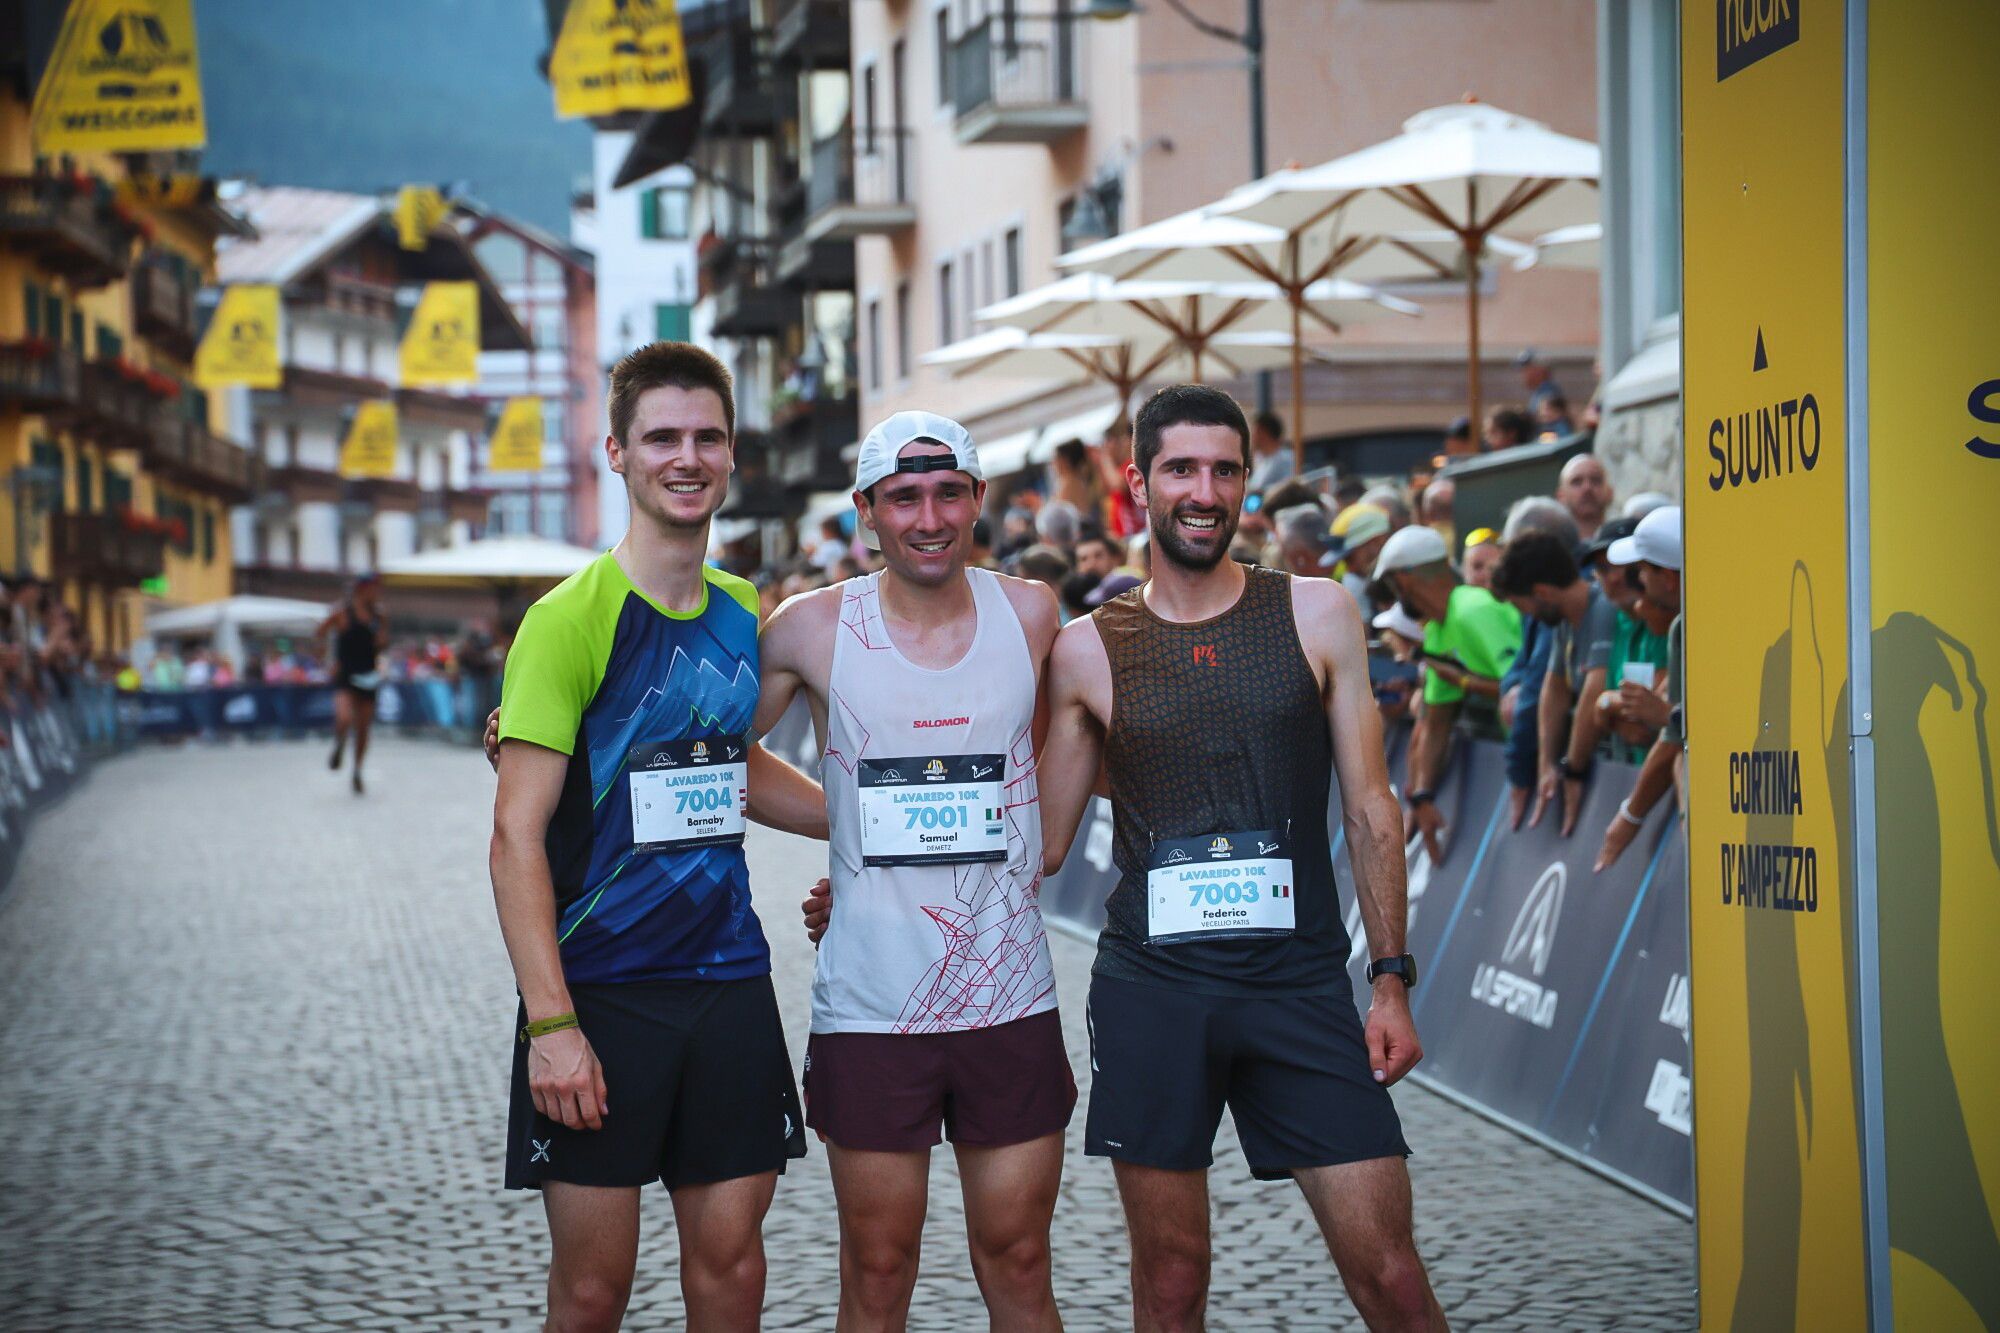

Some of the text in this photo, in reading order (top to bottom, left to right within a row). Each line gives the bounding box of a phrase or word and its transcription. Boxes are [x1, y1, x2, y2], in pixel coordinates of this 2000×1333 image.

[1708, 393, 1821, 492] SUUNTO
[913, 717, 970, 728] SALOMON
[665, 773, 718, 787] LAVAREDO
[720, 771, 735, 782] 10K
[1729, 750, 1803, 815] CORTINA
[675, 787, 732, 815] 7004
[893, 791, 955, 803] LAVAREDO
[958, 790, 980, 801] 10K
[687, 815, 725, 827] Barnaby
[904, 805, 968, 830] 7001
[696, 827, 718, 835] SELLERS
[919, 832, 958, 843] Samuel
[926, 844, 952, 852] DEMETZ
[1179, 868, 1241, 881] LAVAREDO
[1245, 866, 1266, 877] 10K
[1721, 843, 1818, 912] D'AMPEZZO
[1188, 881, 1260, 908] 7003
[1203, 907, 1248, 919] Federico
[1200, 920, 1232, 928] VECELLIO
